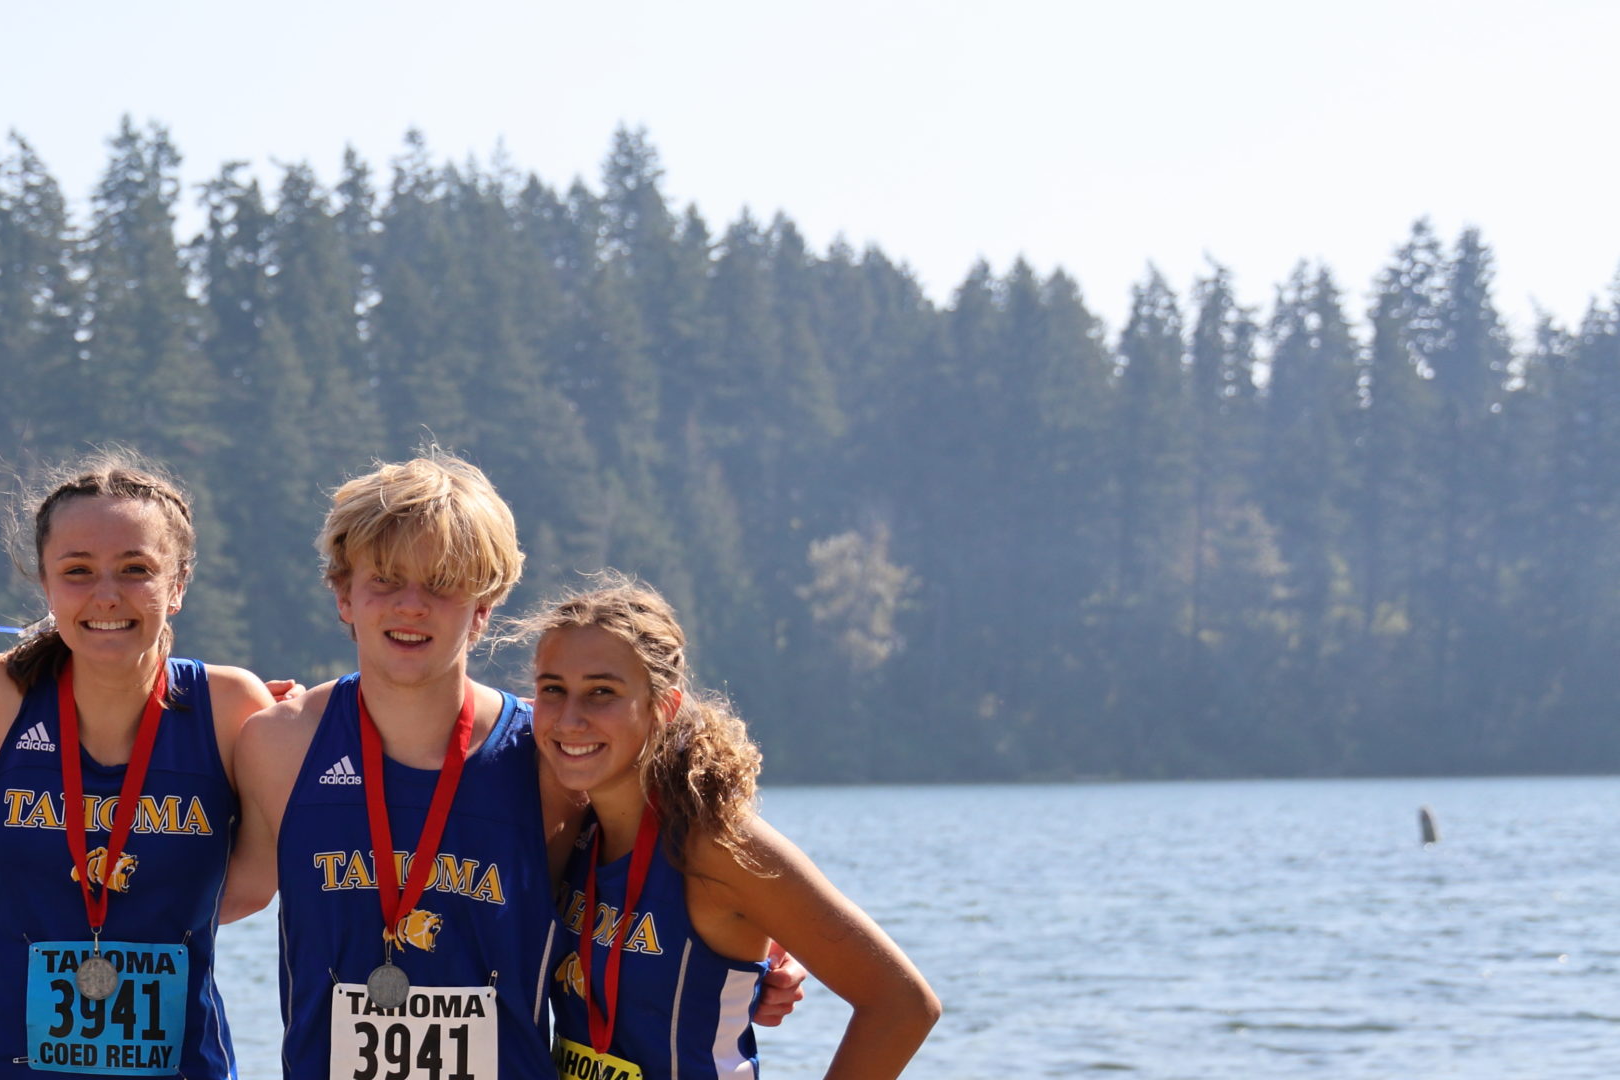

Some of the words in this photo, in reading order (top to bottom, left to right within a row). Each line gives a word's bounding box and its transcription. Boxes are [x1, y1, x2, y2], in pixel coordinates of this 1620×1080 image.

[16, 740, 56, 752] adidas
[319, 773, 362, 785] adidas
[48, 979, 166, 1041] 3941
[39, 1041, 98, 1067] COED
[106, 1044, 173, 1069] RELAY
